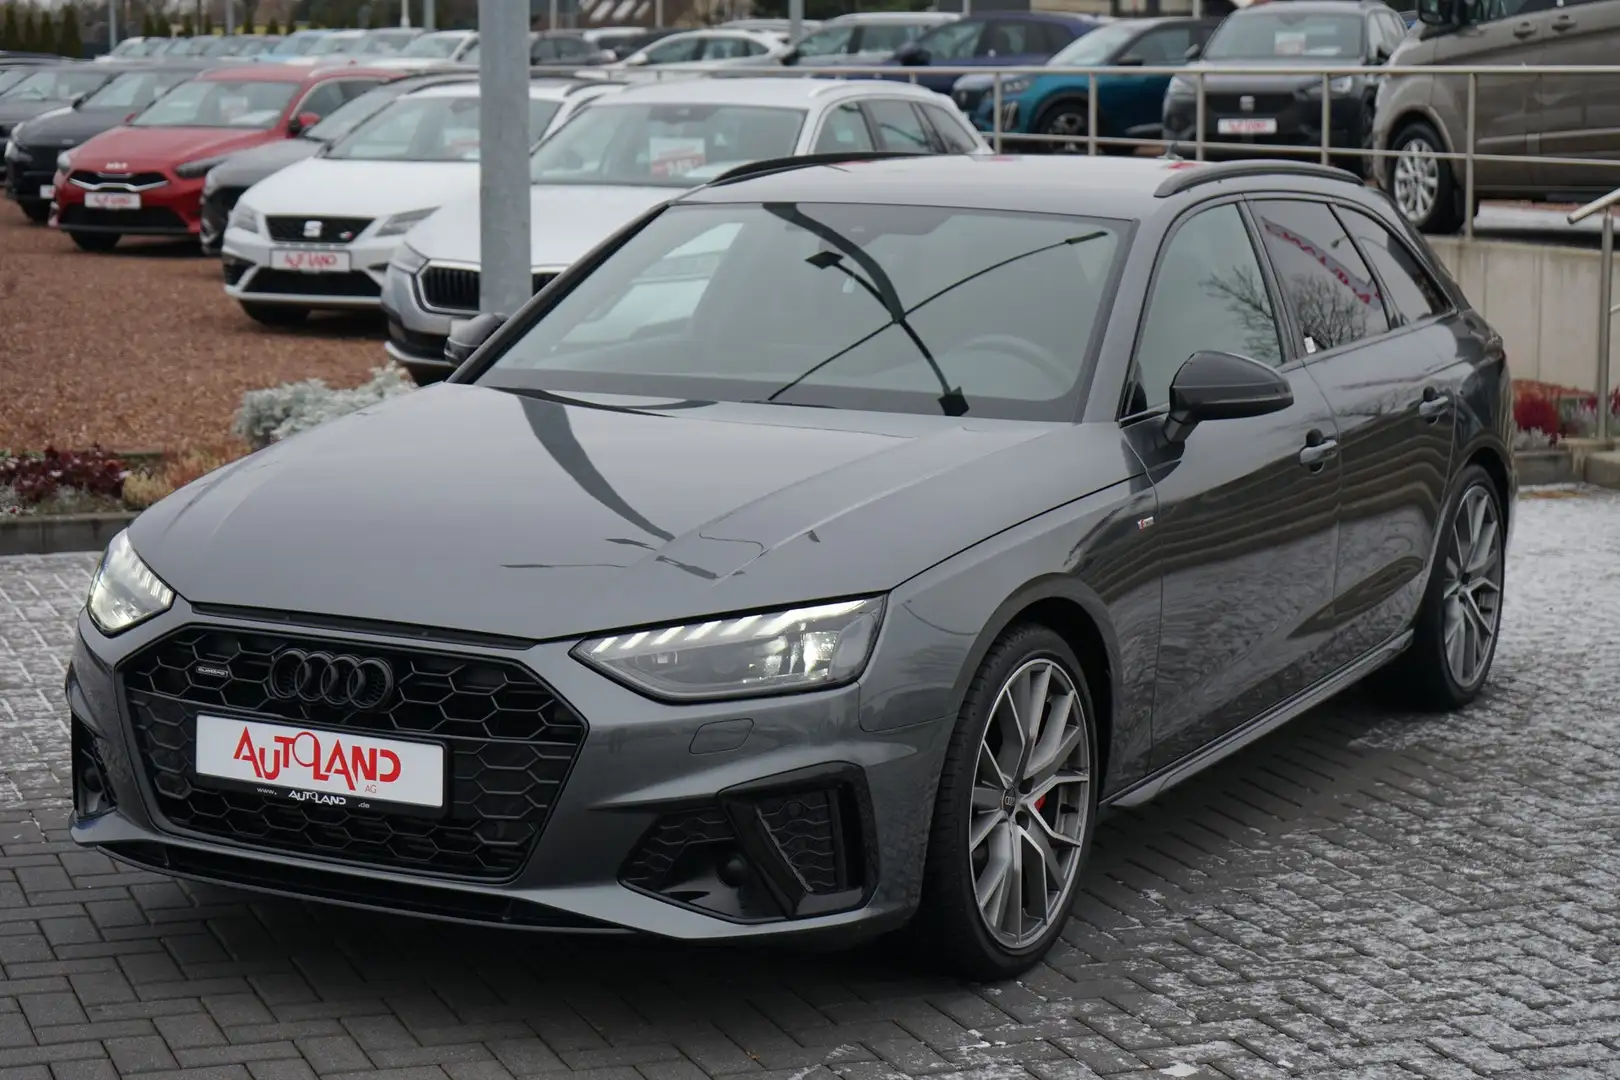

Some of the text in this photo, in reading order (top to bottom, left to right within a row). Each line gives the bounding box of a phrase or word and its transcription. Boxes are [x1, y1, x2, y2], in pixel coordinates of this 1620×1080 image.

[233, 726, 402, 791] AUTOLAND
[365, 784, 377, 794] AG
[288, 790, 347, 805] AUTOLAND
